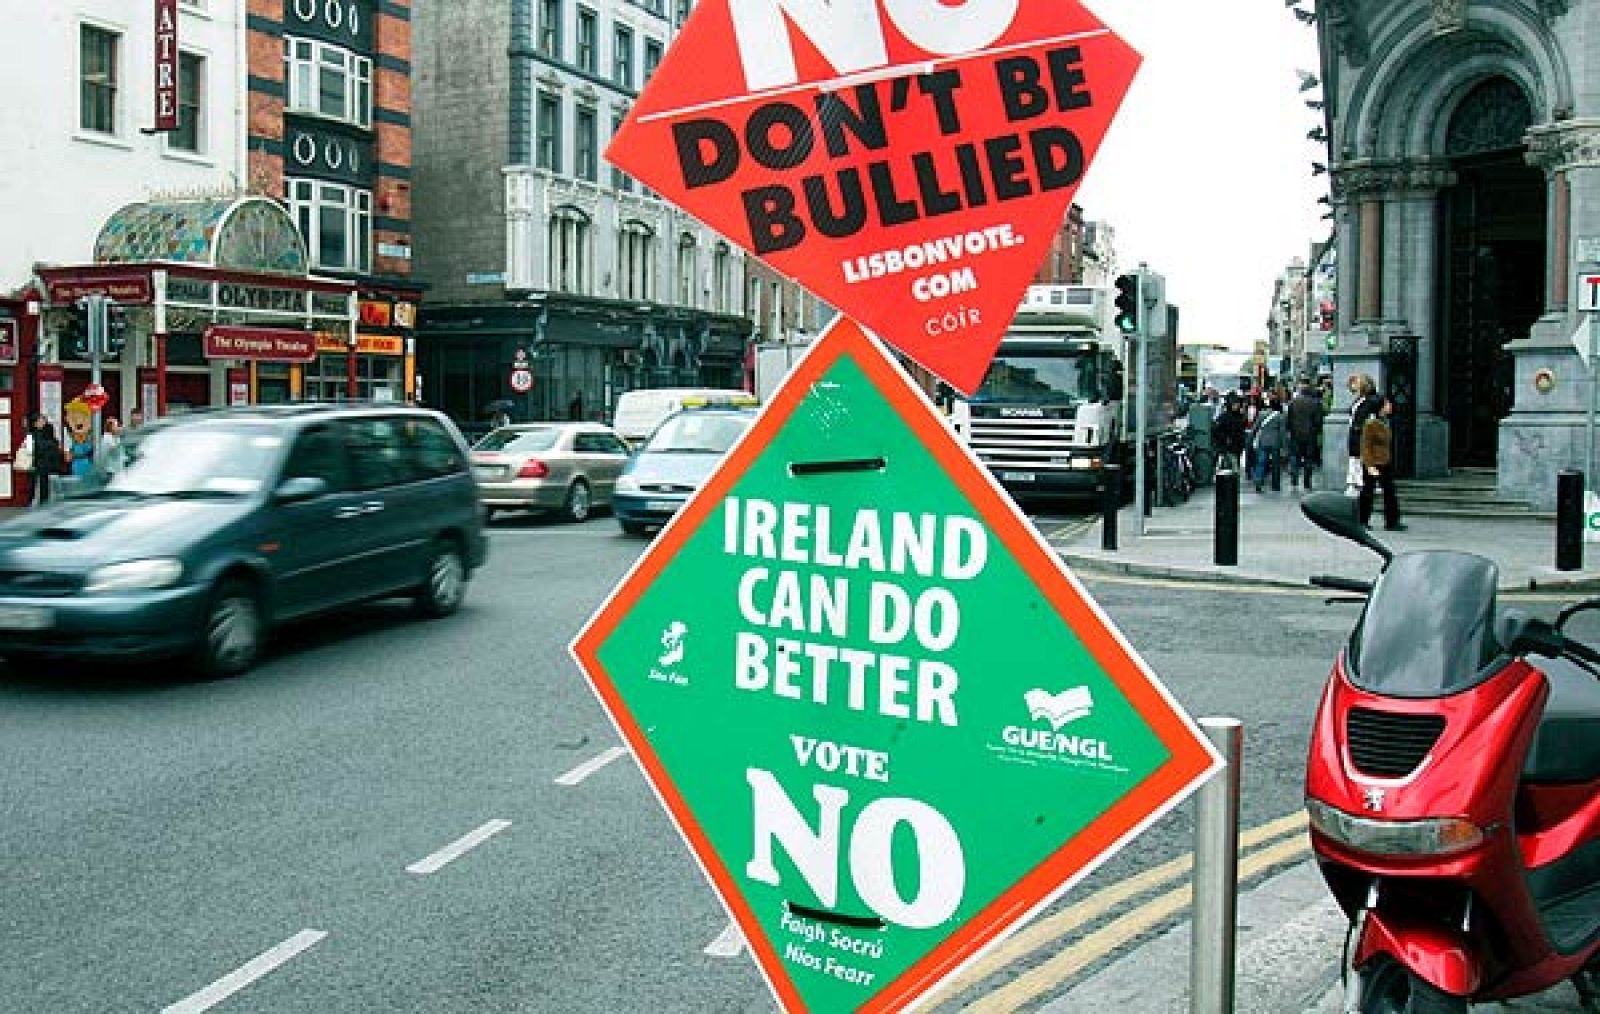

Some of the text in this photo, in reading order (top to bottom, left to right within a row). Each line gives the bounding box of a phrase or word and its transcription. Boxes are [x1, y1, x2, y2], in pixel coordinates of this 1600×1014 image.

[671, 45, 1092, 190] DON'T BE
[741, 127, 1085, 257] BULLIED
[842, 223, 1025, 285] LISBONVOTE.
[911, 267, 977, 302] COM
[724, 496, 988, 580] IRELAND
[738, 567, 961, 652] CAN DO
[735, 631, 959, 727] BETTER
[790, 734, 889, 783] VOTE
[746, 767, 966, 929] NO
